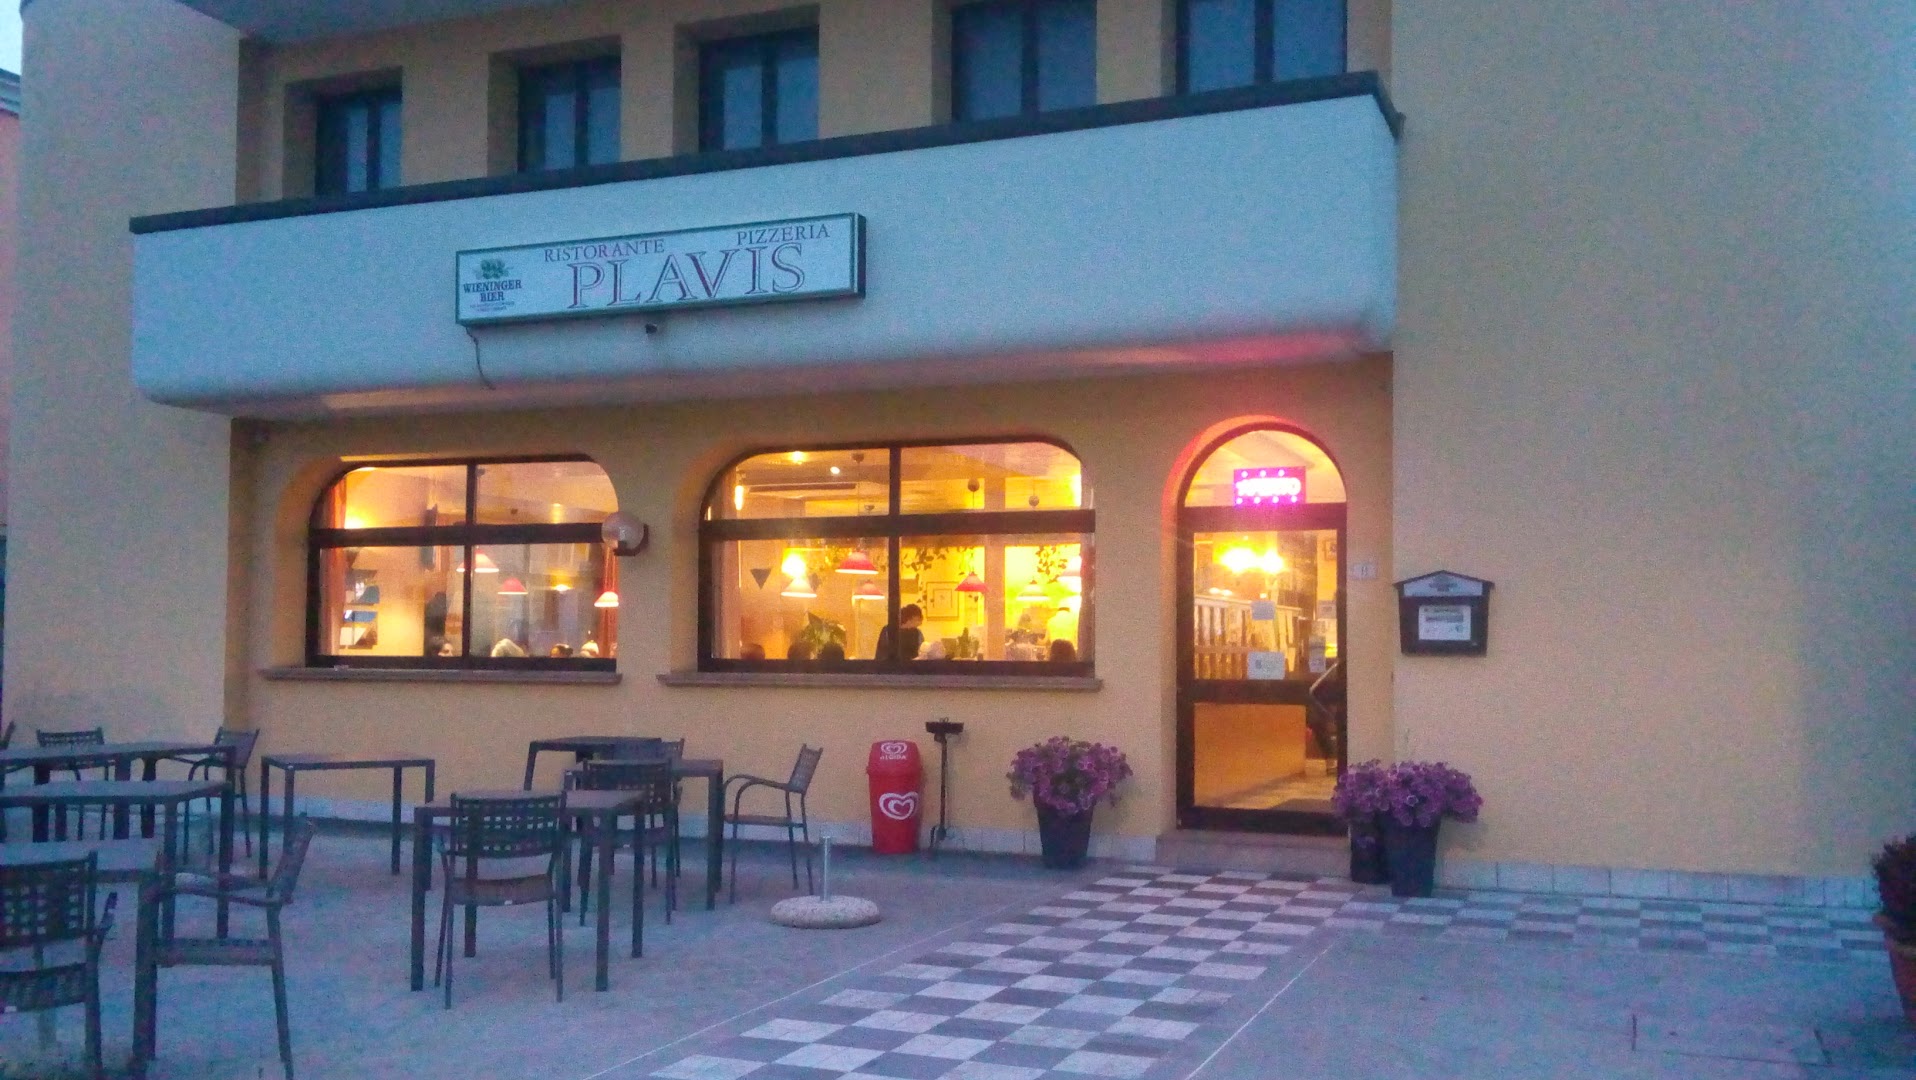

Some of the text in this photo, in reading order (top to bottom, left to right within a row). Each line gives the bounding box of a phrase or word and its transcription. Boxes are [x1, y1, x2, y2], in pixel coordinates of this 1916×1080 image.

[544, 223, 830, 262] RISTORANTE PIZZERIA
[463, 279, 522, 293] WIENINGER
[567, 241, 805, 309] PLAVIS
[480, 291, 505, 302] BIER
